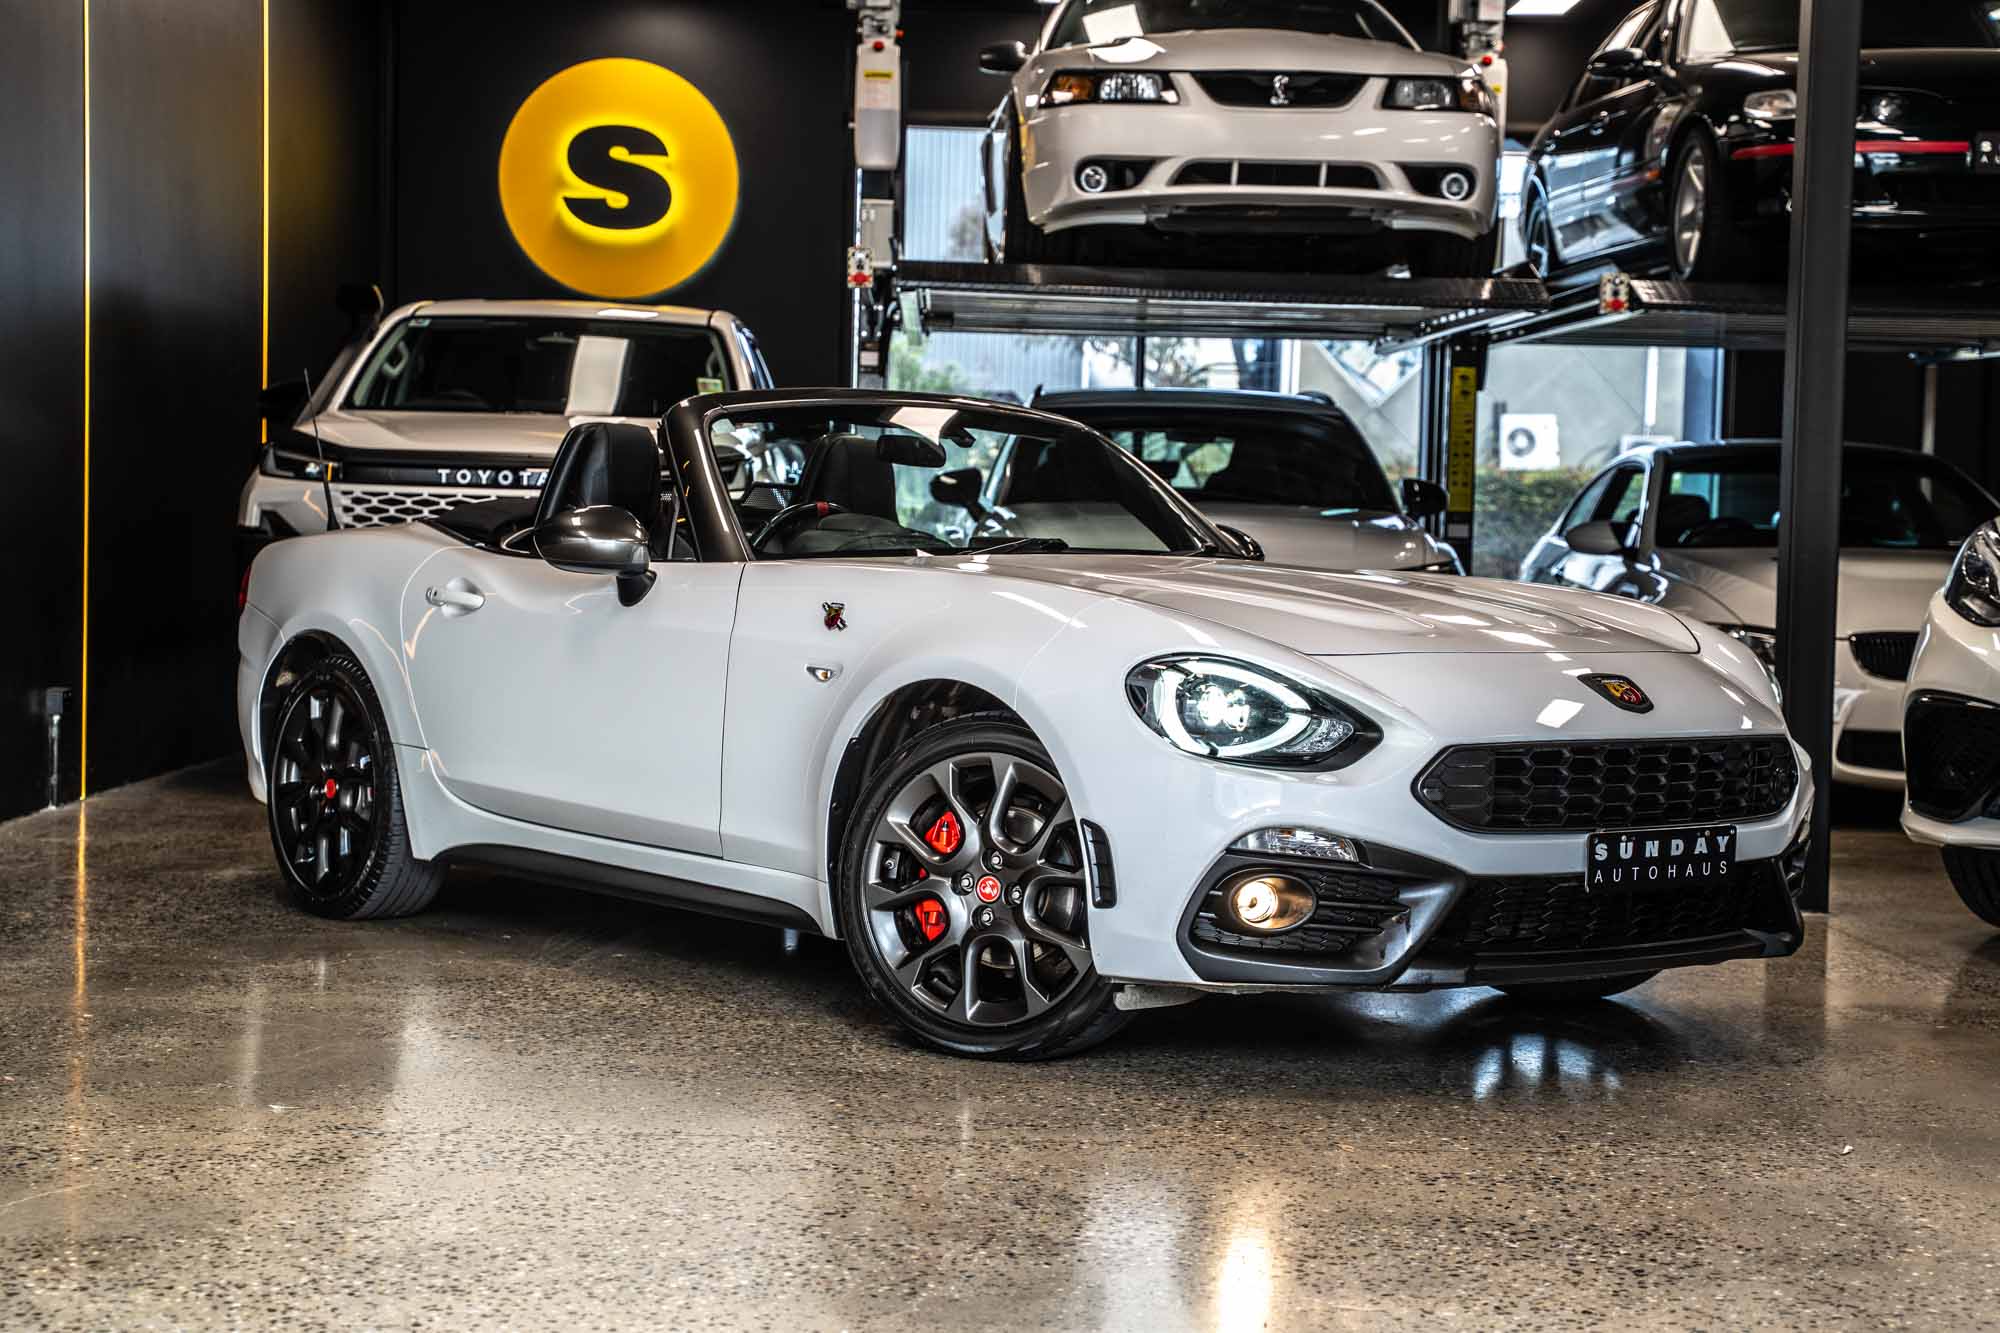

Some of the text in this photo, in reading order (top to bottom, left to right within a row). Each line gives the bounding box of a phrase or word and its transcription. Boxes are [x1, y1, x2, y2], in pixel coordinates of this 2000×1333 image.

[562, 125, 672, 229] S
[437, 468, 548, 486] TOYOTA
[1594, 835, 1730, 861] SUNDAY
[1594, 860, 1728, 884] AUTOHAUS
